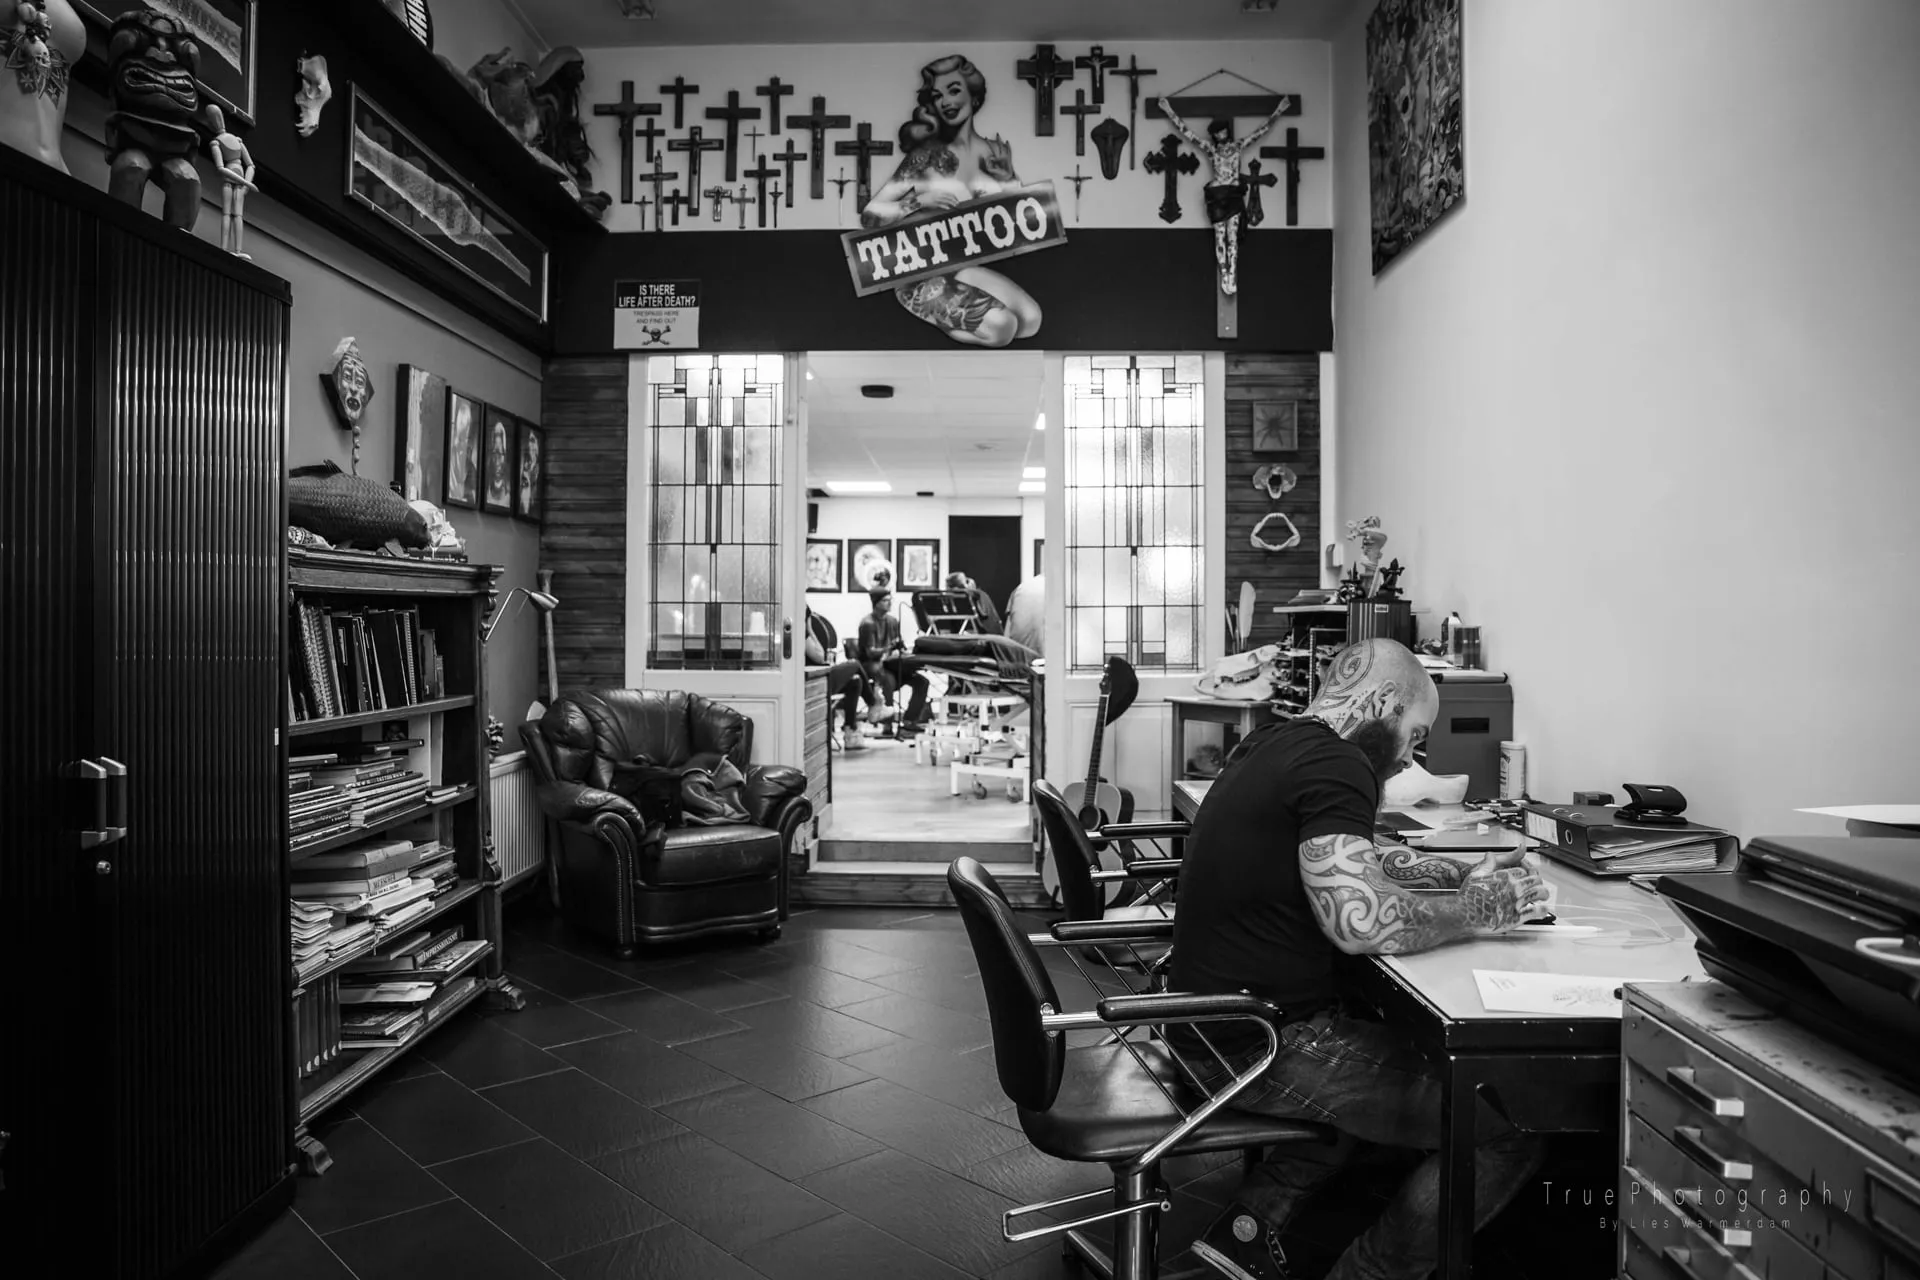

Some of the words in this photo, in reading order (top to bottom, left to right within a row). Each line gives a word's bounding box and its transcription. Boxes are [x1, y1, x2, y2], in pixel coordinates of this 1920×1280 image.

[856, 197, 1047, 281] TATTOO
[639, 284, 648, 296] IS
[648, 284, 675, 295] THERE
[619, 296, 635, 307] LIFE
[637, 296, 663, 307] AFTER
[664, 295, 696, 307] DEATH?
